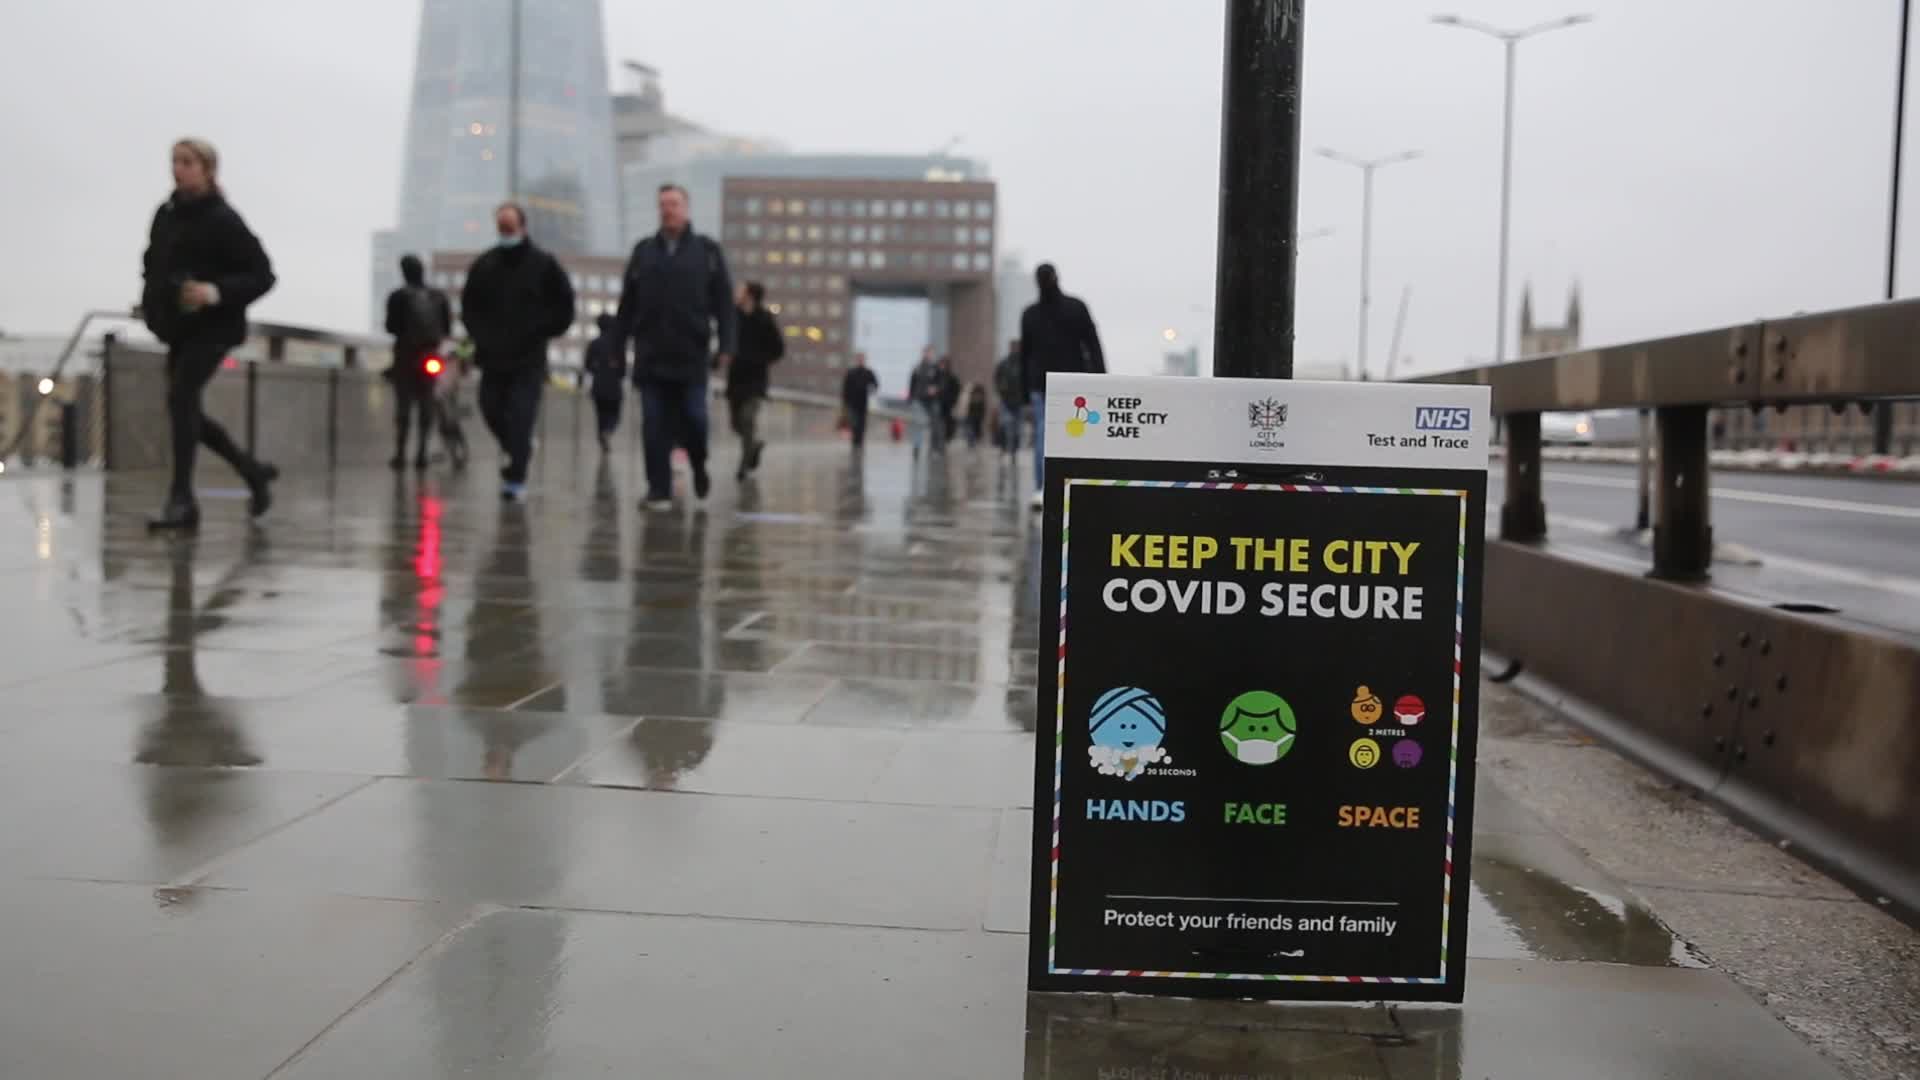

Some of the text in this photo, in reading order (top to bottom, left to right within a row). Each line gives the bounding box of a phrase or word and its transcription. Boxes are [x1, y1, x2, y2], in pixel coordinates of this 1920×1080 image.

[1107, 397, 1142, 410] KEEP
[1107, 411, 1168, 425] THE CITY
[1417, 408, 1468, 429] NHS
[1107, 426, 1140, 438] SAFE
[1367, 433, 1469, 448] Test and Trace
[1111, 534, 1420, 575] KEEP THE CITY
[1102, 578, 1424, 620] COVID SECURE
[1375, 728, 1406, 737] METRES
[1159, 769, 1197, 777] SECONDS
[1086, 798, 1186, 823] HANDS
[1224, 802, 1287, 825] FACE
[1338, 804, 1420, 829] SPACE
[1104, 909, 1397, 937] Protect your friends and family
